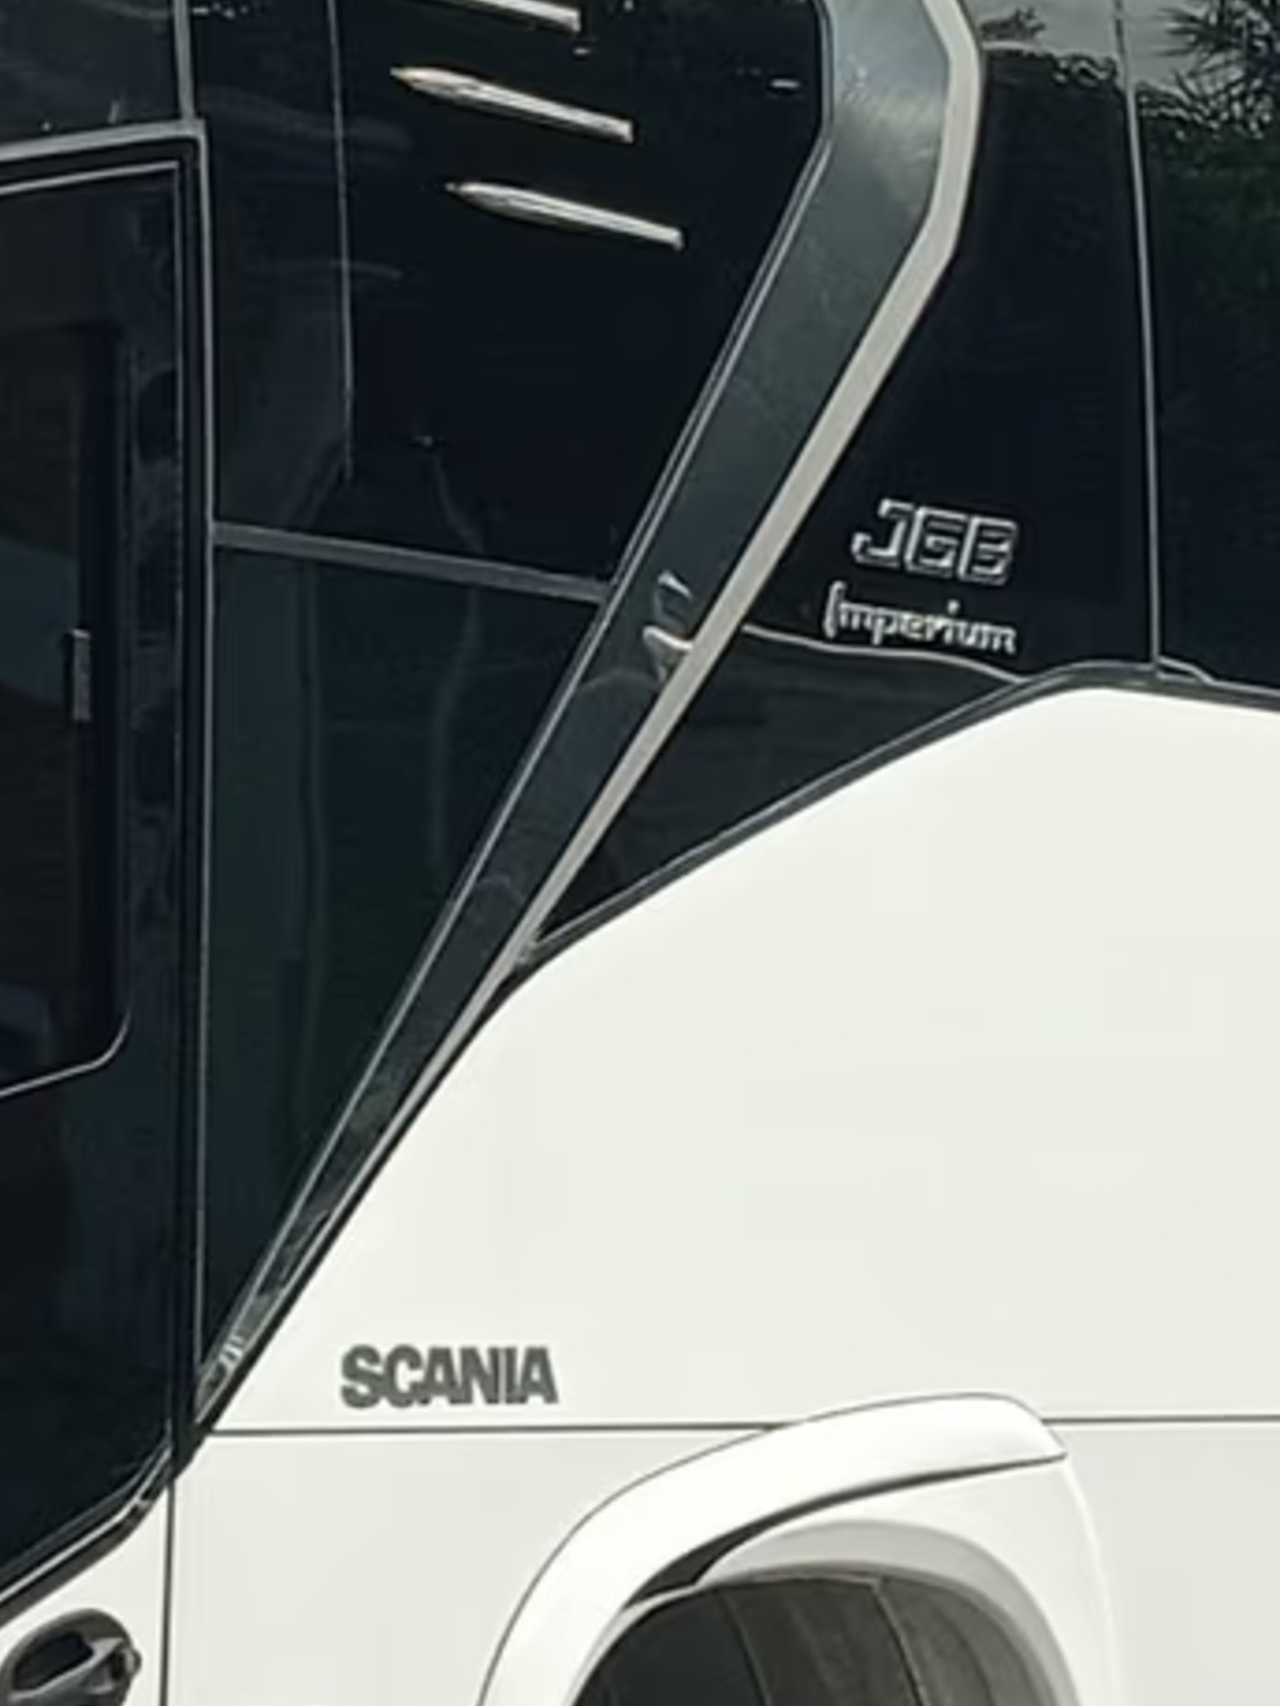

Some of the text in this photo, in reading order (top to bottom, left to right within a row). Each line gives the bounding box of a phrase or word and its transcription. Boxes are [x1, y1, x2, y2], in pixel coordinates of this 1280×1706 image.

[850, 498, 1018, 586] JGB
[823, 581, 1017, 654] Imperium
[341, 1344, 559, 1409] SCANIA
